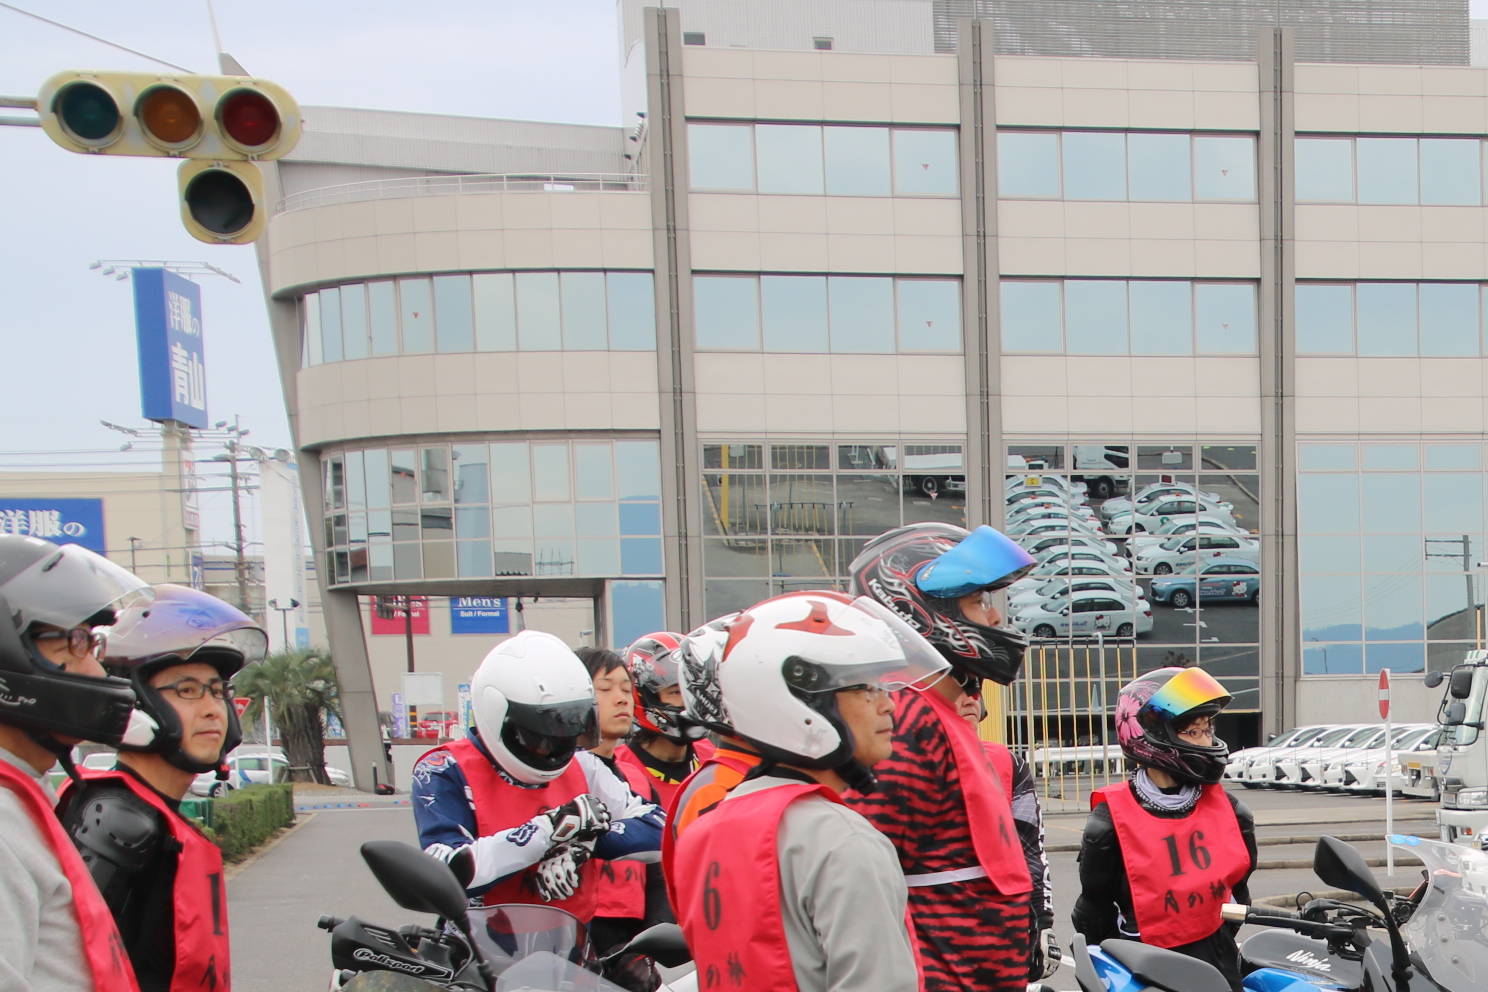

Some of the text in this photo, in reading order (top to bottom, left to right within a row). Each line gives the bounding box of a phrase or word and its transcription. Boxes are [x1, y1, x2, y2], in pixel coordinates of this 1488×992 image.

[168, 291, 199, 337] 洋服の
[171, 342, 204, 410] 青山
[0, 509, 87, 537] 洋服の
[457, 596, 501, 608] Men's
[868, 578, 921, 631] Kabuto
[1161, 830, 1211, 877] 16
[703, 861, 721, 931] 6
[354, 948, 426, 974] Polisport
[1286, 949, 1332, 972] Ninja
